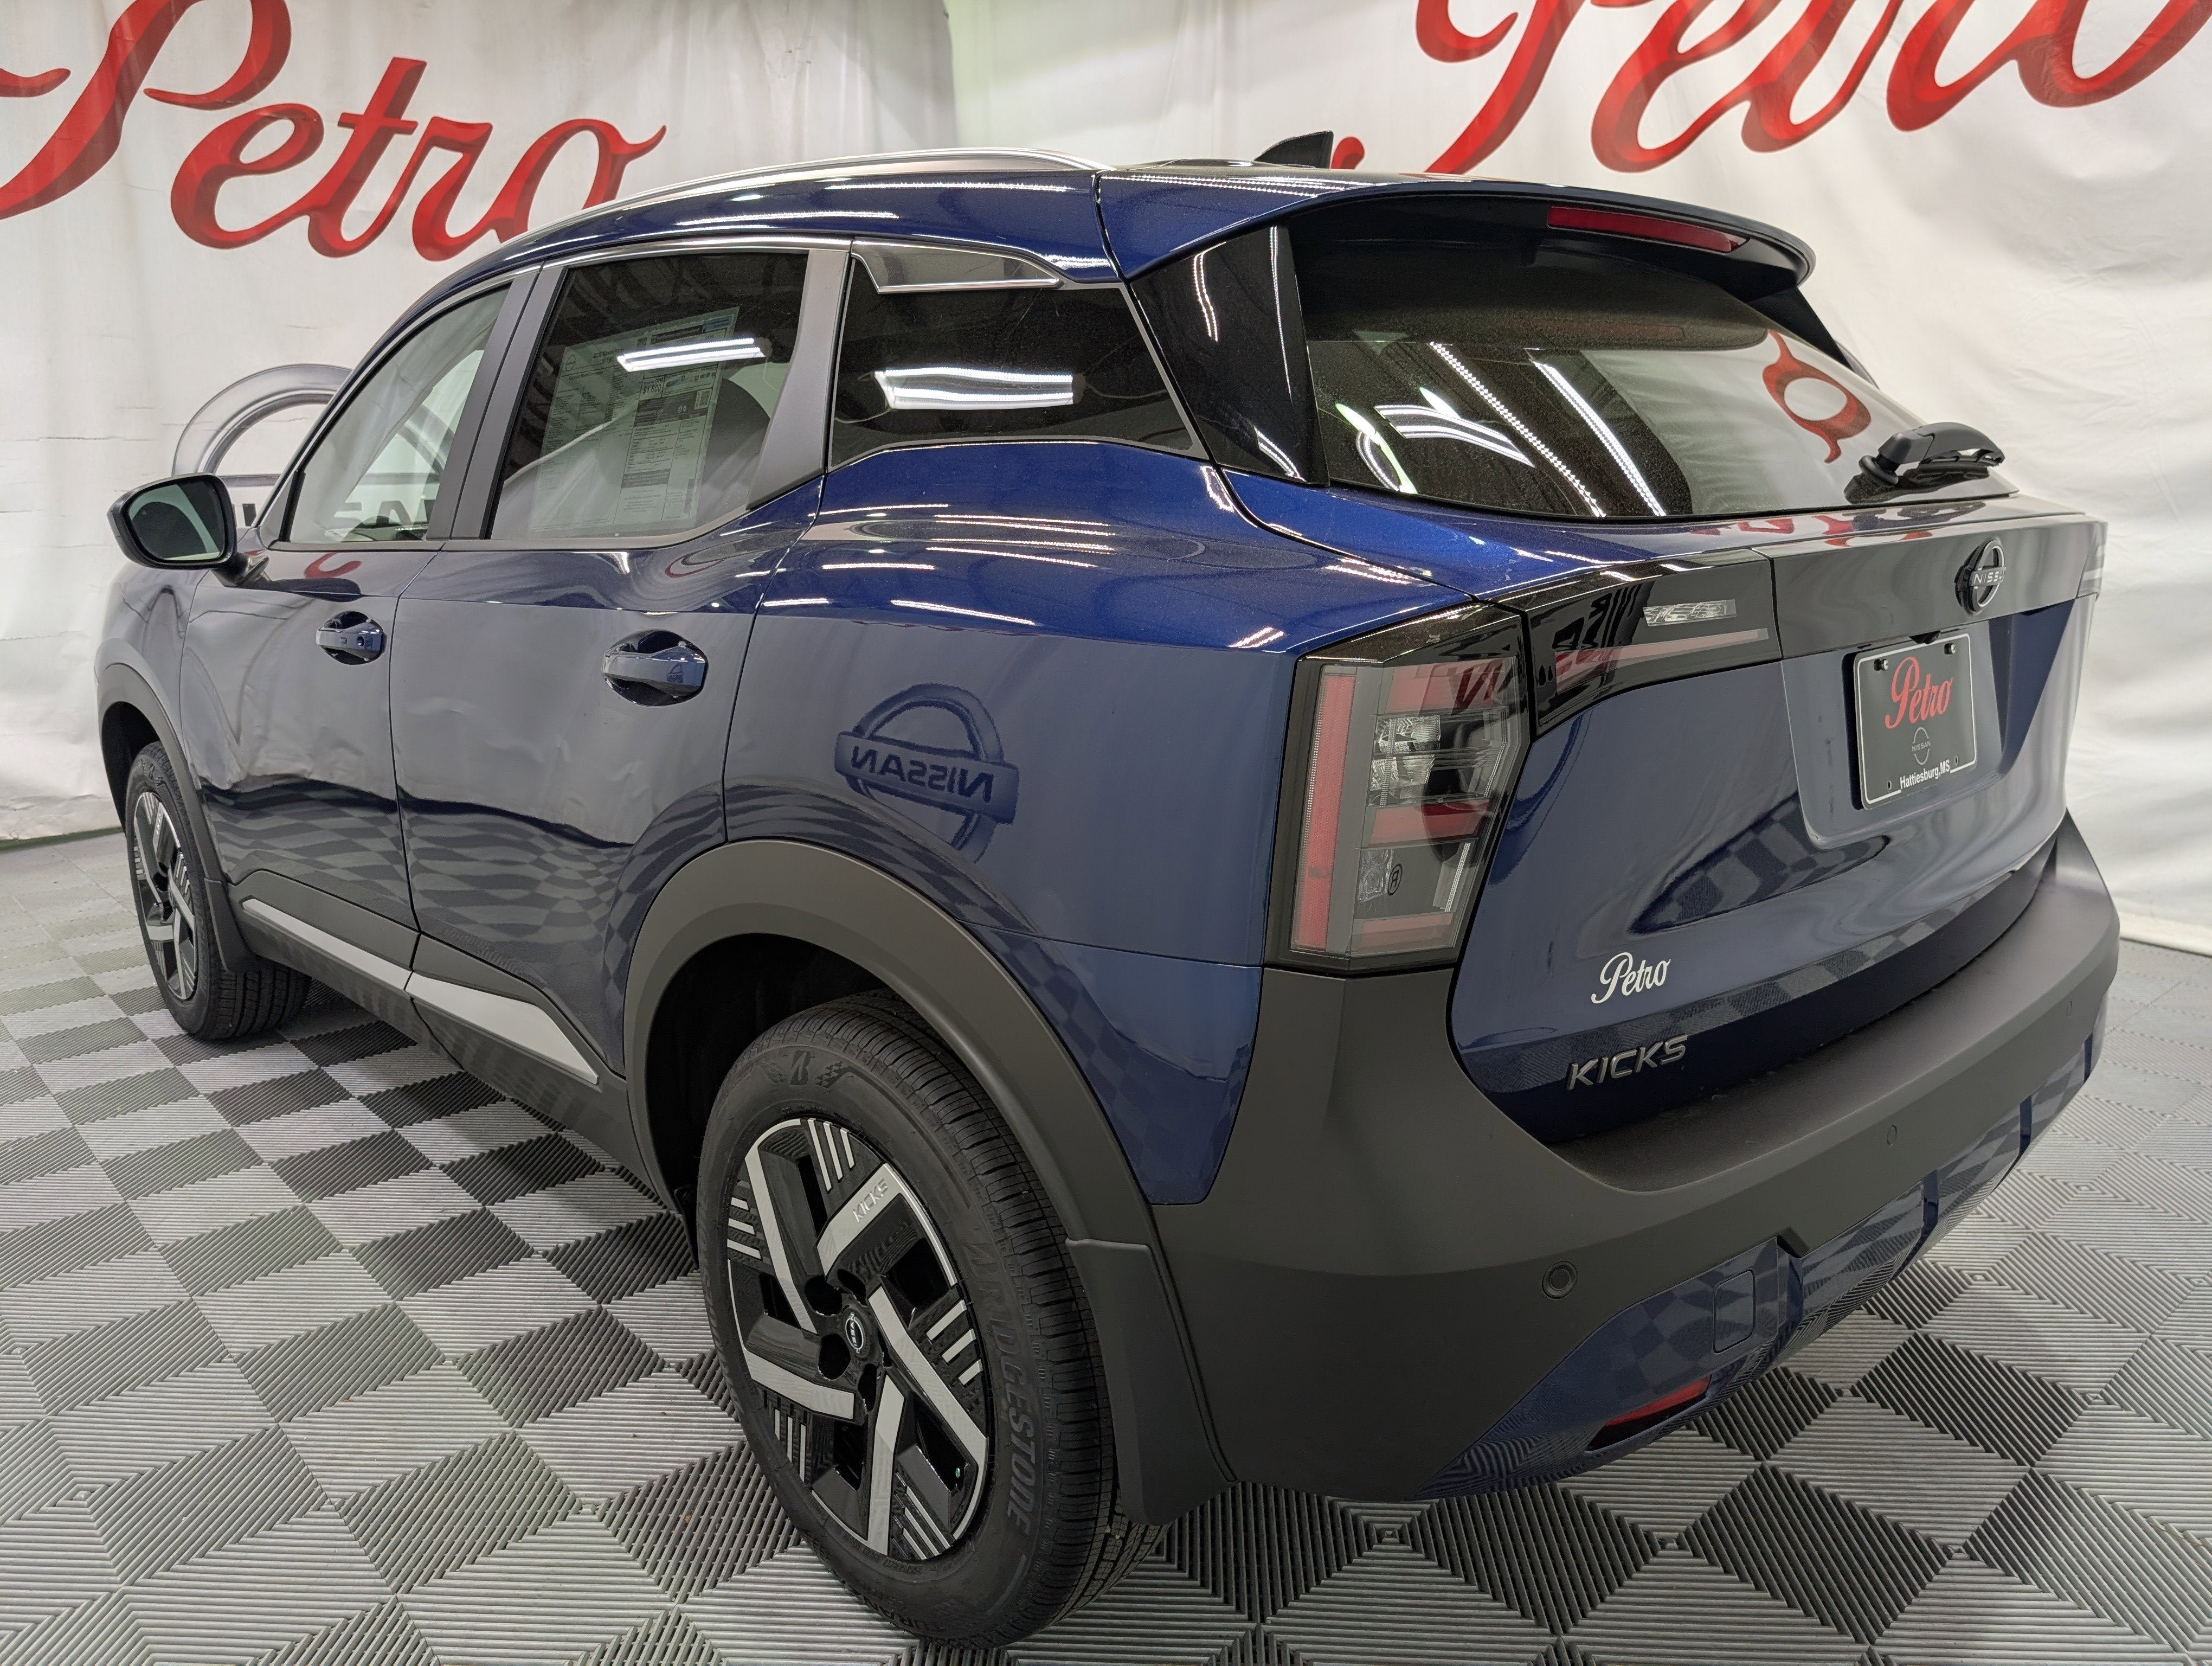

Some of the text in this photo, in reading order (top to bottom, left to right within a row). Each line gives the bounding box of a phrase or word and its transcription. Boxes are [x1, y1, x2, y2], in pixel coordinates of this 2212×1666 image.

[0, 0, 666, 261] Petro
[1885, 656, 1953, 729] Petro
[1912, 741, 1931, 752] NISSAN
[1591, 952, 1671, 1004] Petro
[1566, 1034, 1688, 1091] KICKS
[853, 1178, 888, 1222] KICKS
